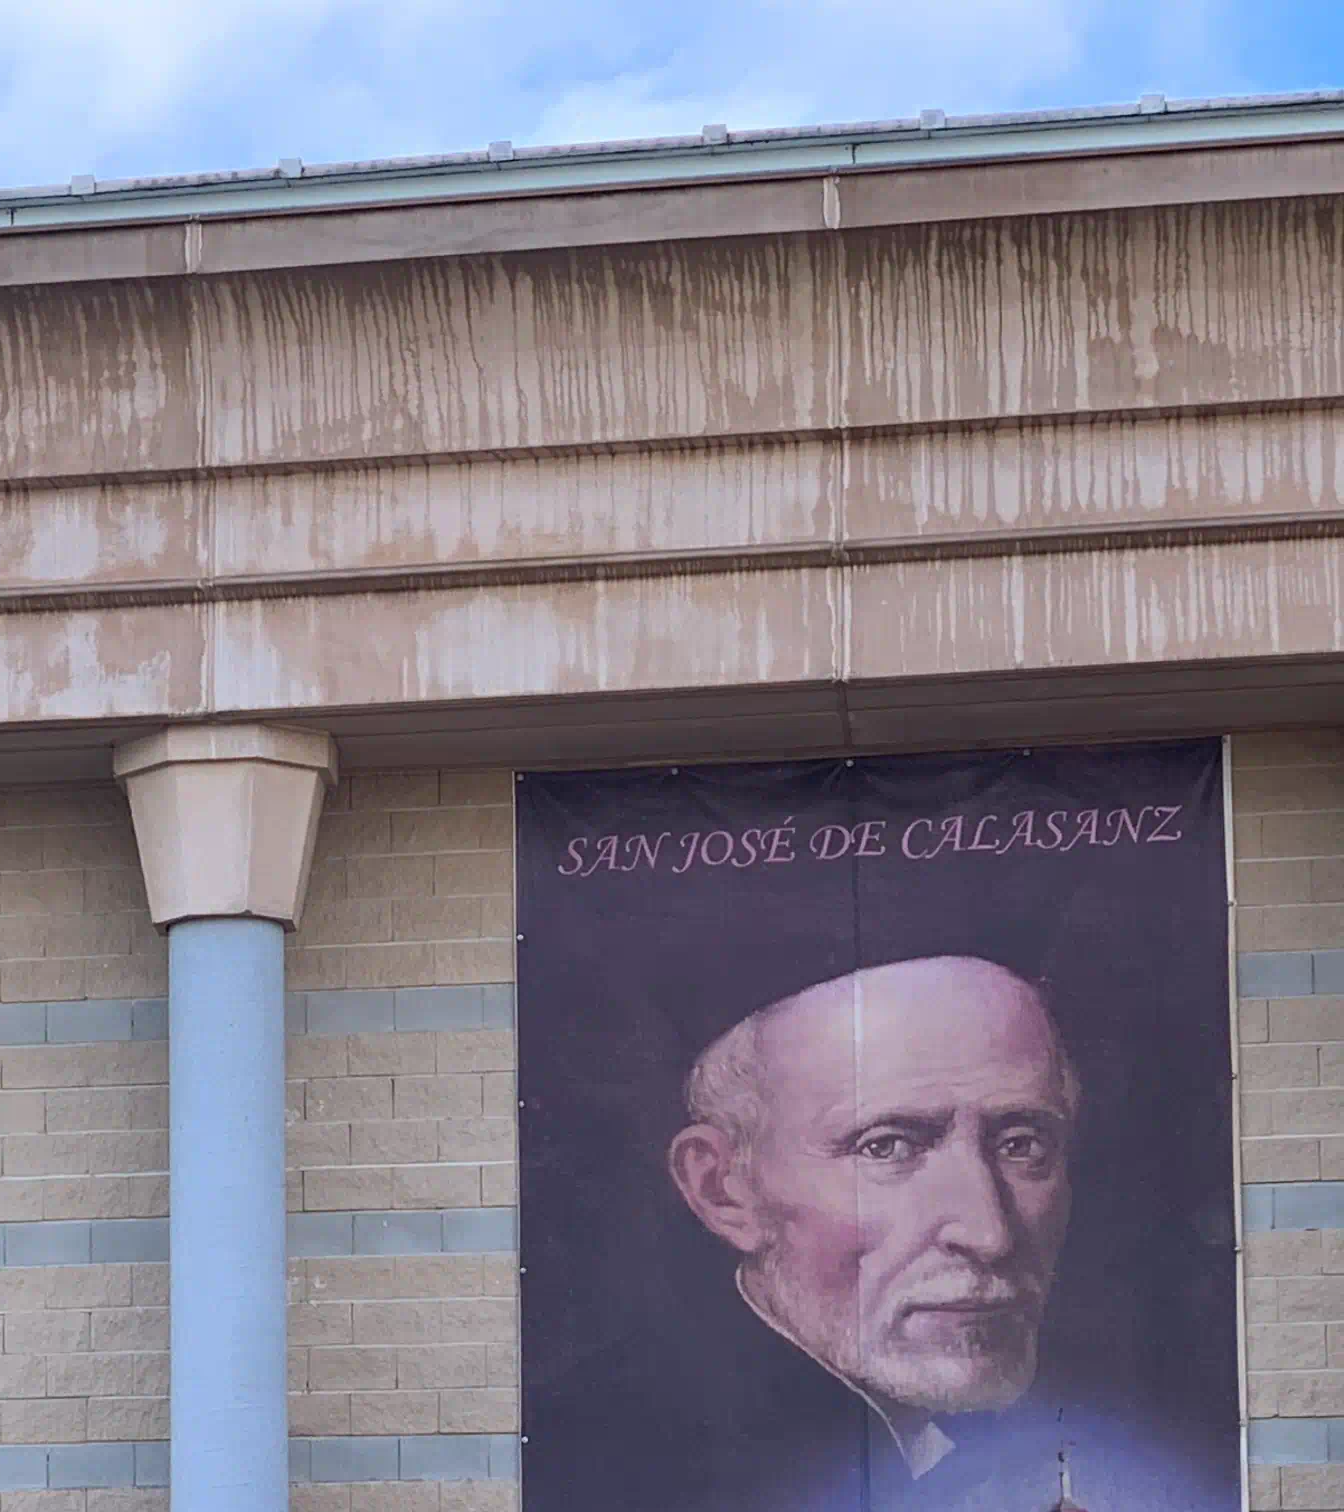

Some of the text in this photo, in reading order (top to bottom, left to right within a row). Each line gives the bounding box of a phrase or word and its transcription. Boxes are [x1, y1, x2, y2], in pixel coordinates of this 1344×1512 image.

[558, 804, 1183, 877] SAN JOSÉ DE CALASANZ
